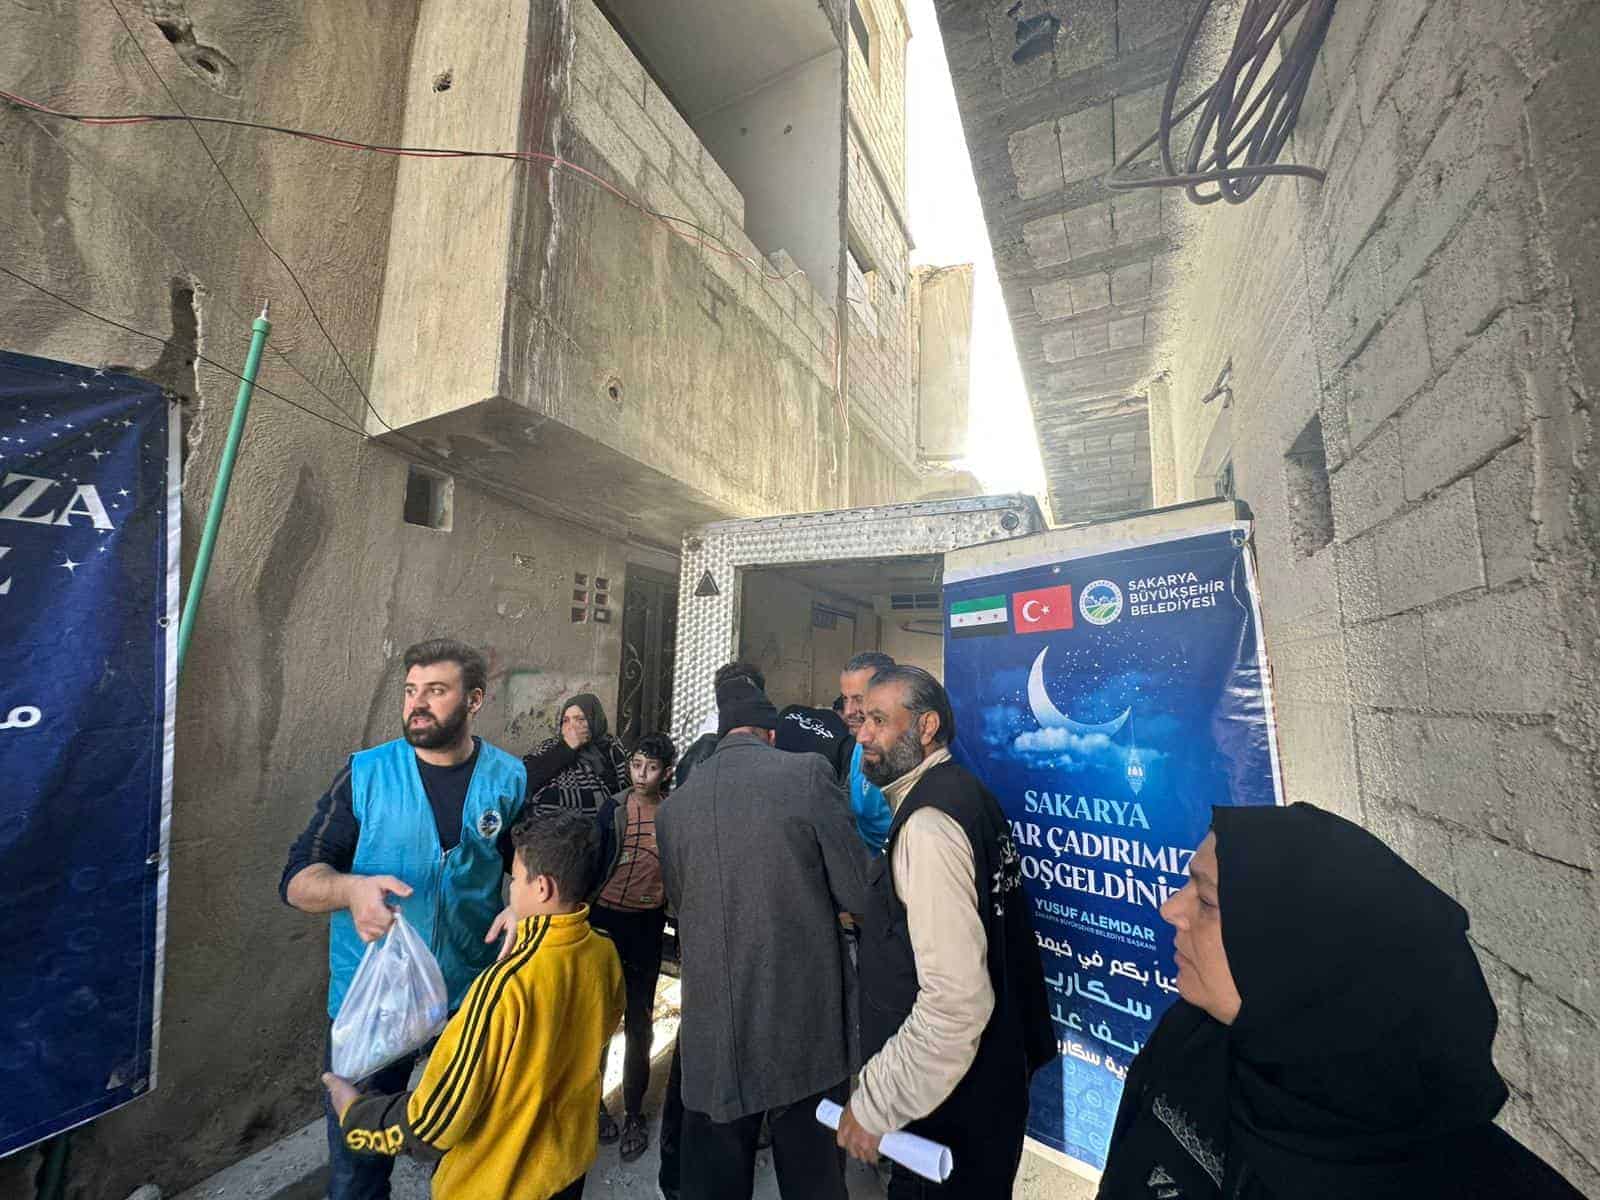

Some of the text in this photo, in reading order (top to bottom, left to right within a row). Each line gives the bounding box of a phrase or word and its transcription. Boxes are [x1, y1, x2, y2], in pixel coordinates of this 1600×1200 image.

[0, 472, 116, 530] ZA
[1128, 572, 1198, 591] SAKARYA
[1129, 579, 1225, 604] BÜYÜKŞEHİR
[1131, 593, 1217, 616] BELEDİYESİ
[1024, 790, 1150, 830] SAKARYA
[1007, 819, 1042, 848] AR
[1047, 827, 1196, 876] ÇADIRIMIZ
[1020, 855, 1181, 909] OŞGELDİNİ
[1034, 897, 1156, 942] YUSUF ALEMDAR
[1034, 930, 1072, 957] خيمة
[1077, 949, 1104, 970] في
[1110, 959, 1150, 986] بكم
[1044, 971, 1152, 1020] سكاري
